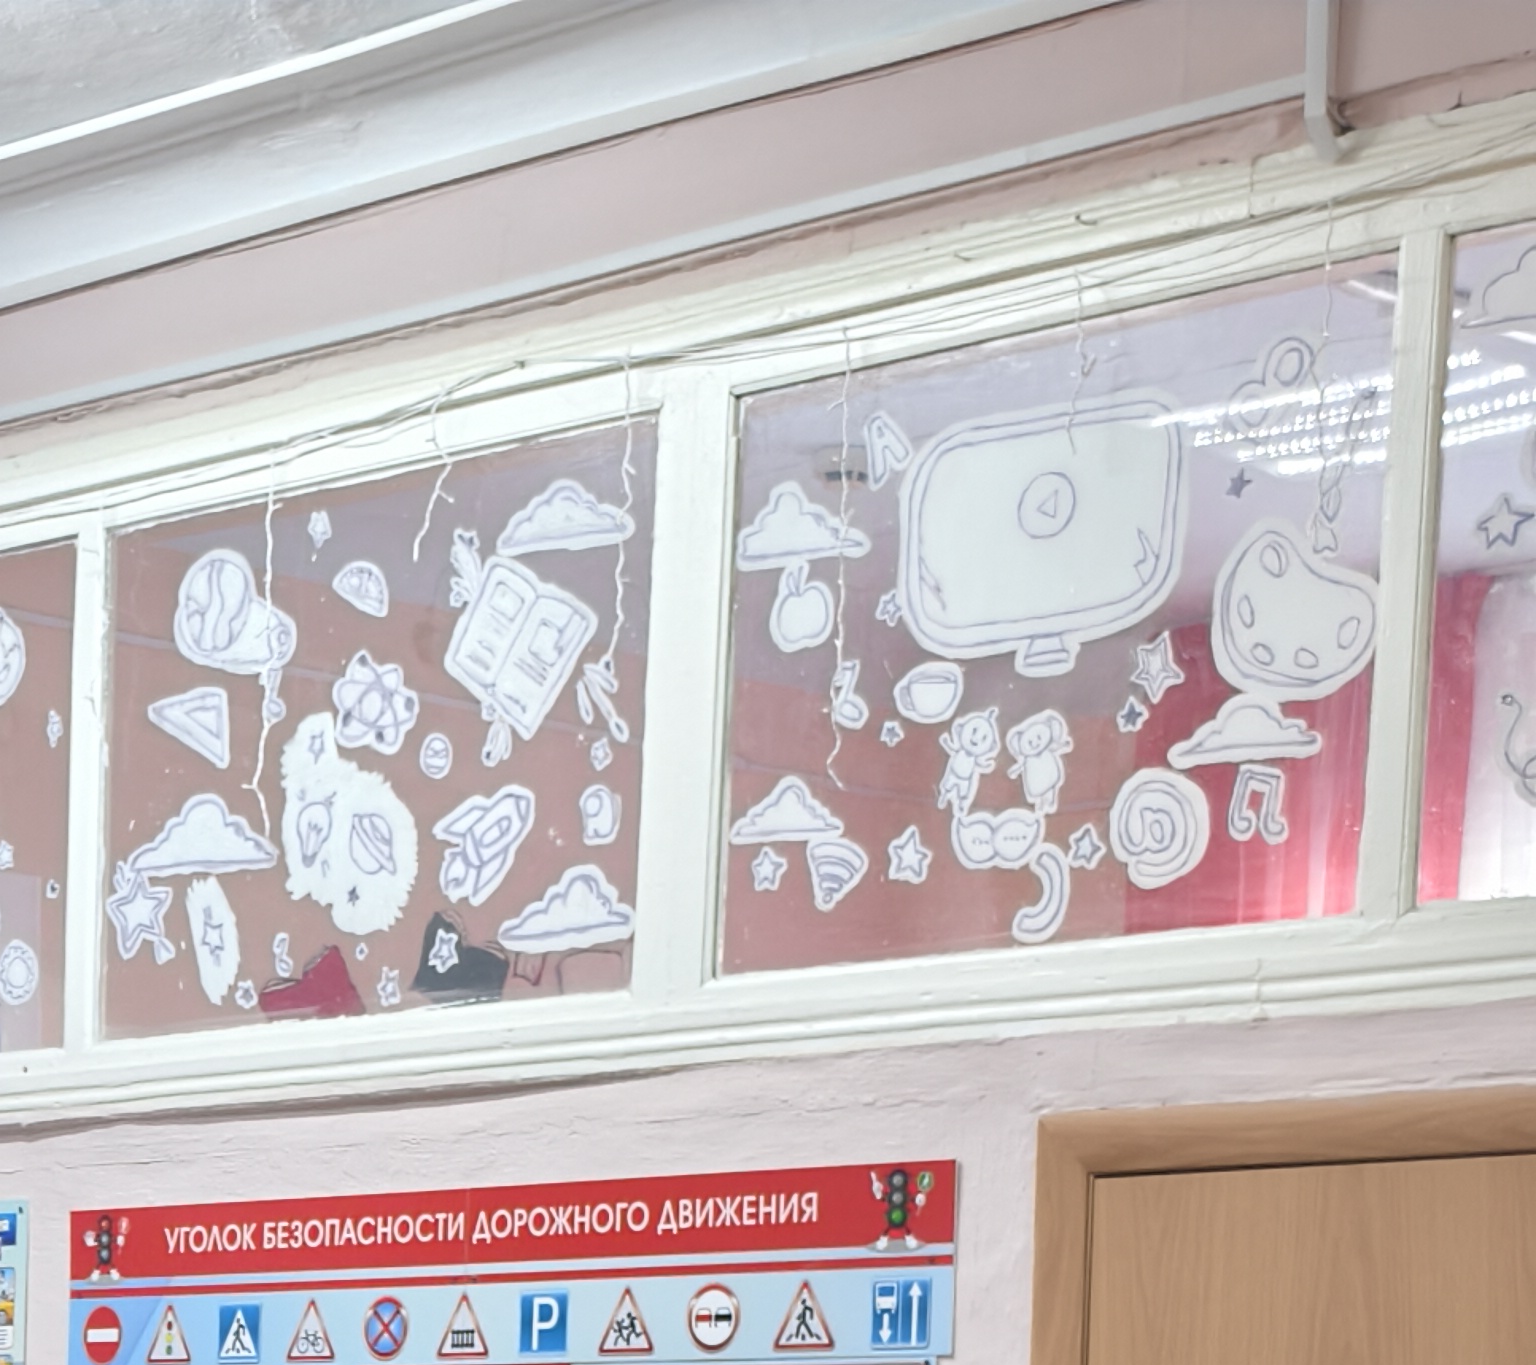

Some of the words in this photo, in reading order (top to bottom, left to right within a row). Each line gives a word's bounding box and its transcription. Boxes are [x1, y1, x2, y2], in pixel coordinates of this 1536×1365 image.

[165, 1223, 257, 1254] УГОЛОК
[263, 1212, 465, 1251] БЕЗОПАСНОСТИ
[472, 1201, 650, 1244] ДОРОЖНОГО
[657, 1192, 819, 1235] ДВИЖЕНИЯ
